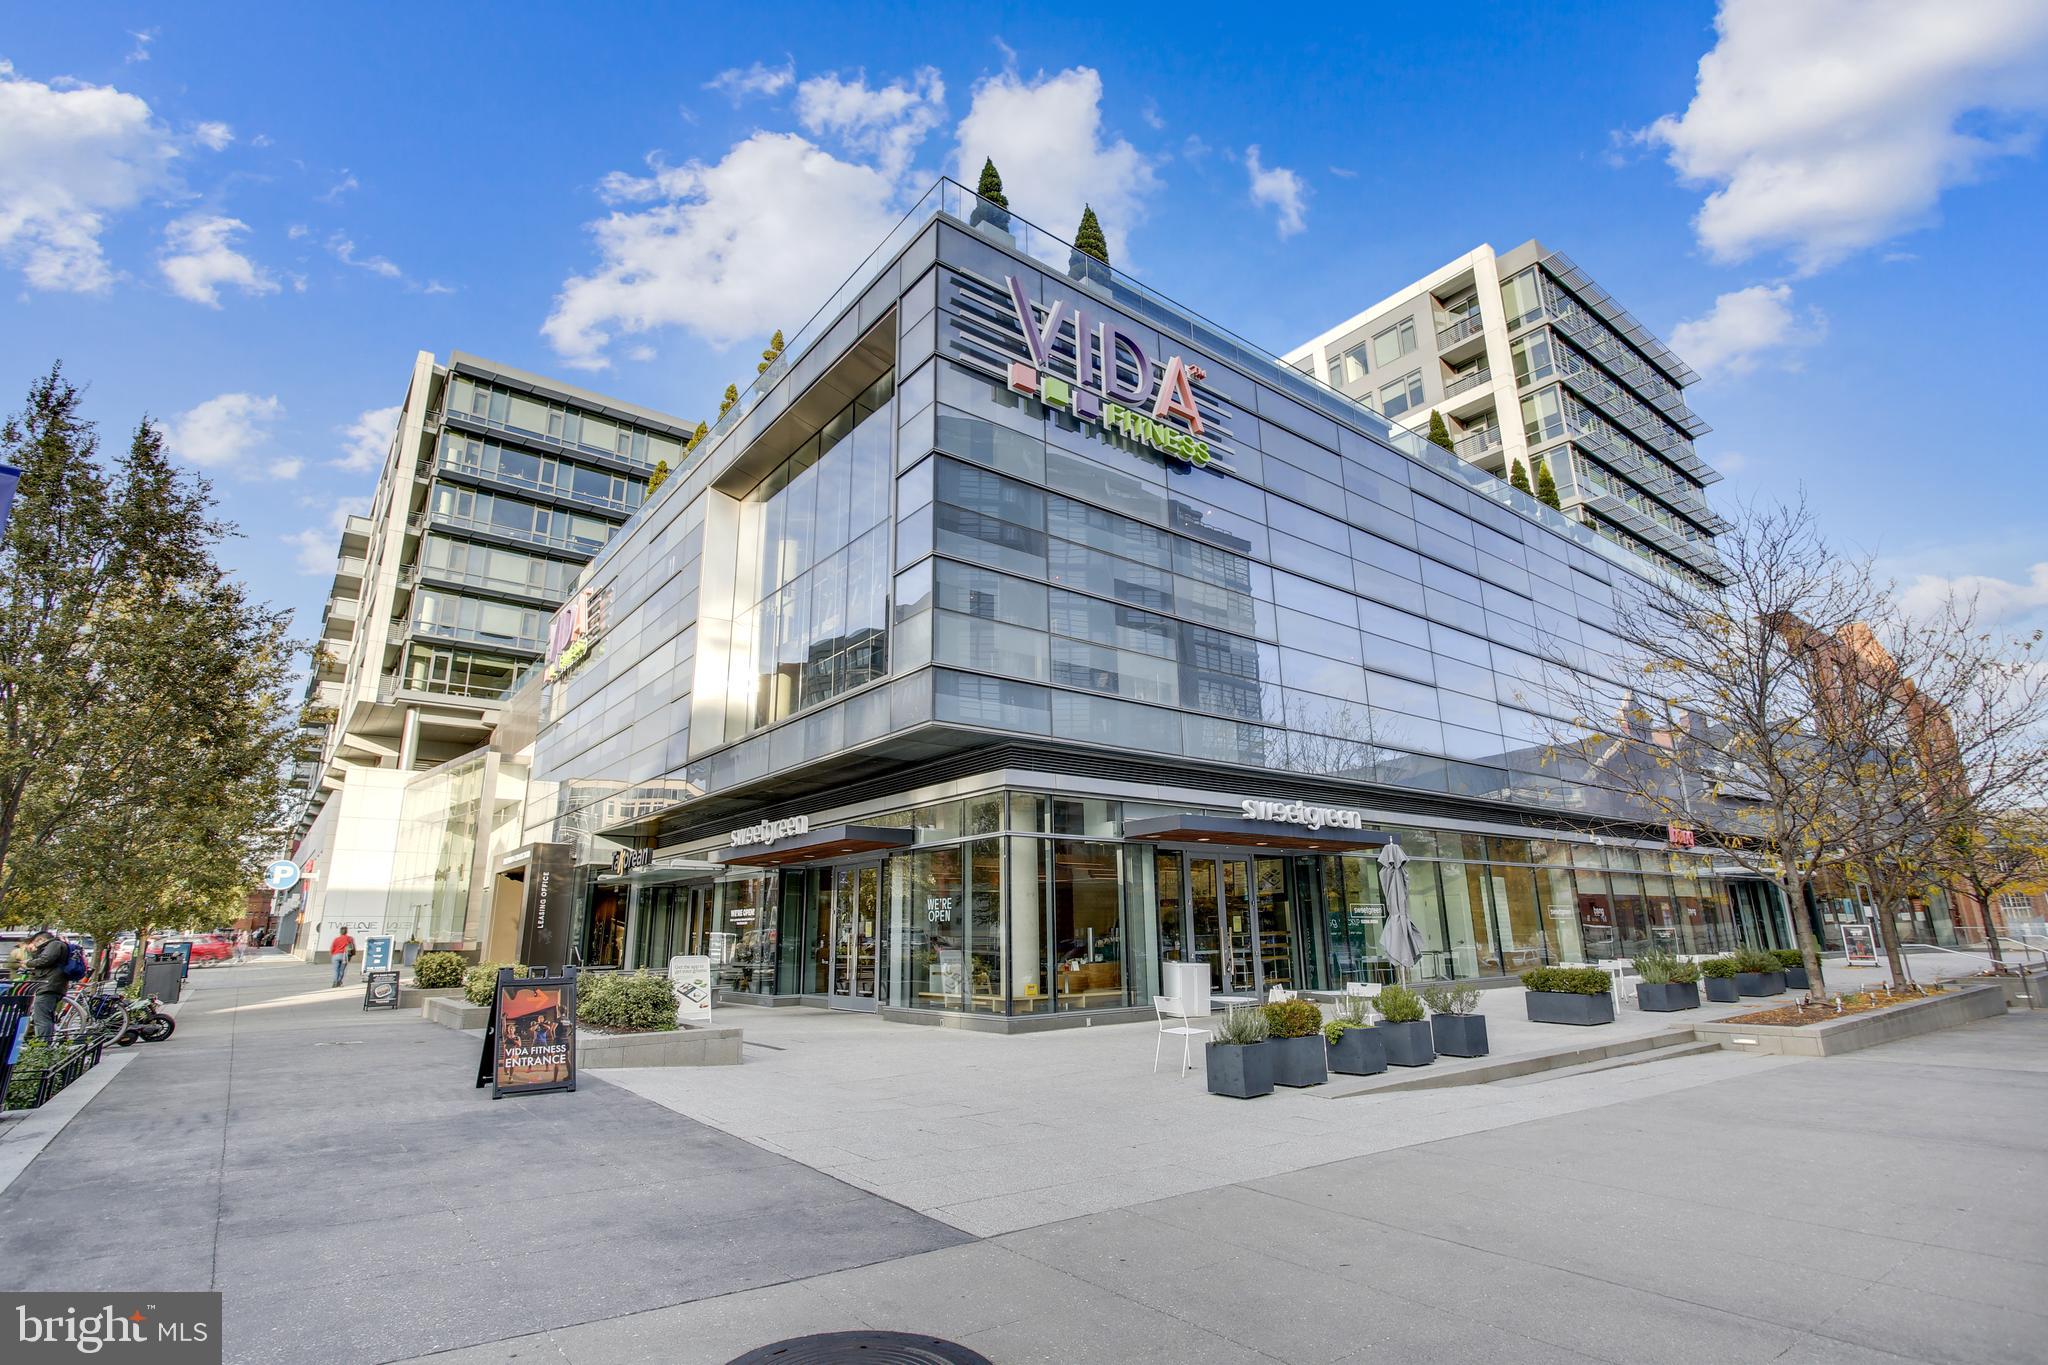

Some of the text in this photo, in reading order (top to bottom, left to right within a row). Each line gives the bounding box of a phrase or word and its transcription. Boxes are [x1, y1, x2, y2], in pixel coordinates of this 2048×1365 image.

[1005, 275, 1204, 435] VIDA
[1103, 402, 1211, 467] FITNESS
[1241, 799, 1362, 831] sweetgreen
[730, 815, 808, 847] sweetgreen
[272, 865, 294, 884] P
[611, 848, 651, 877] TaKorean
[537, 871, 549, 929] LEASING OFFICE
[927, 897, 952, 910] WE'RE
[1353, 906, 1382, 915] sweetgreen
[928, 909, 951, 922] OPEN
[505, 1044, 567, 1057] VIDA FITNESS
[505, 1055, 566, 1068] ENTRANCE
